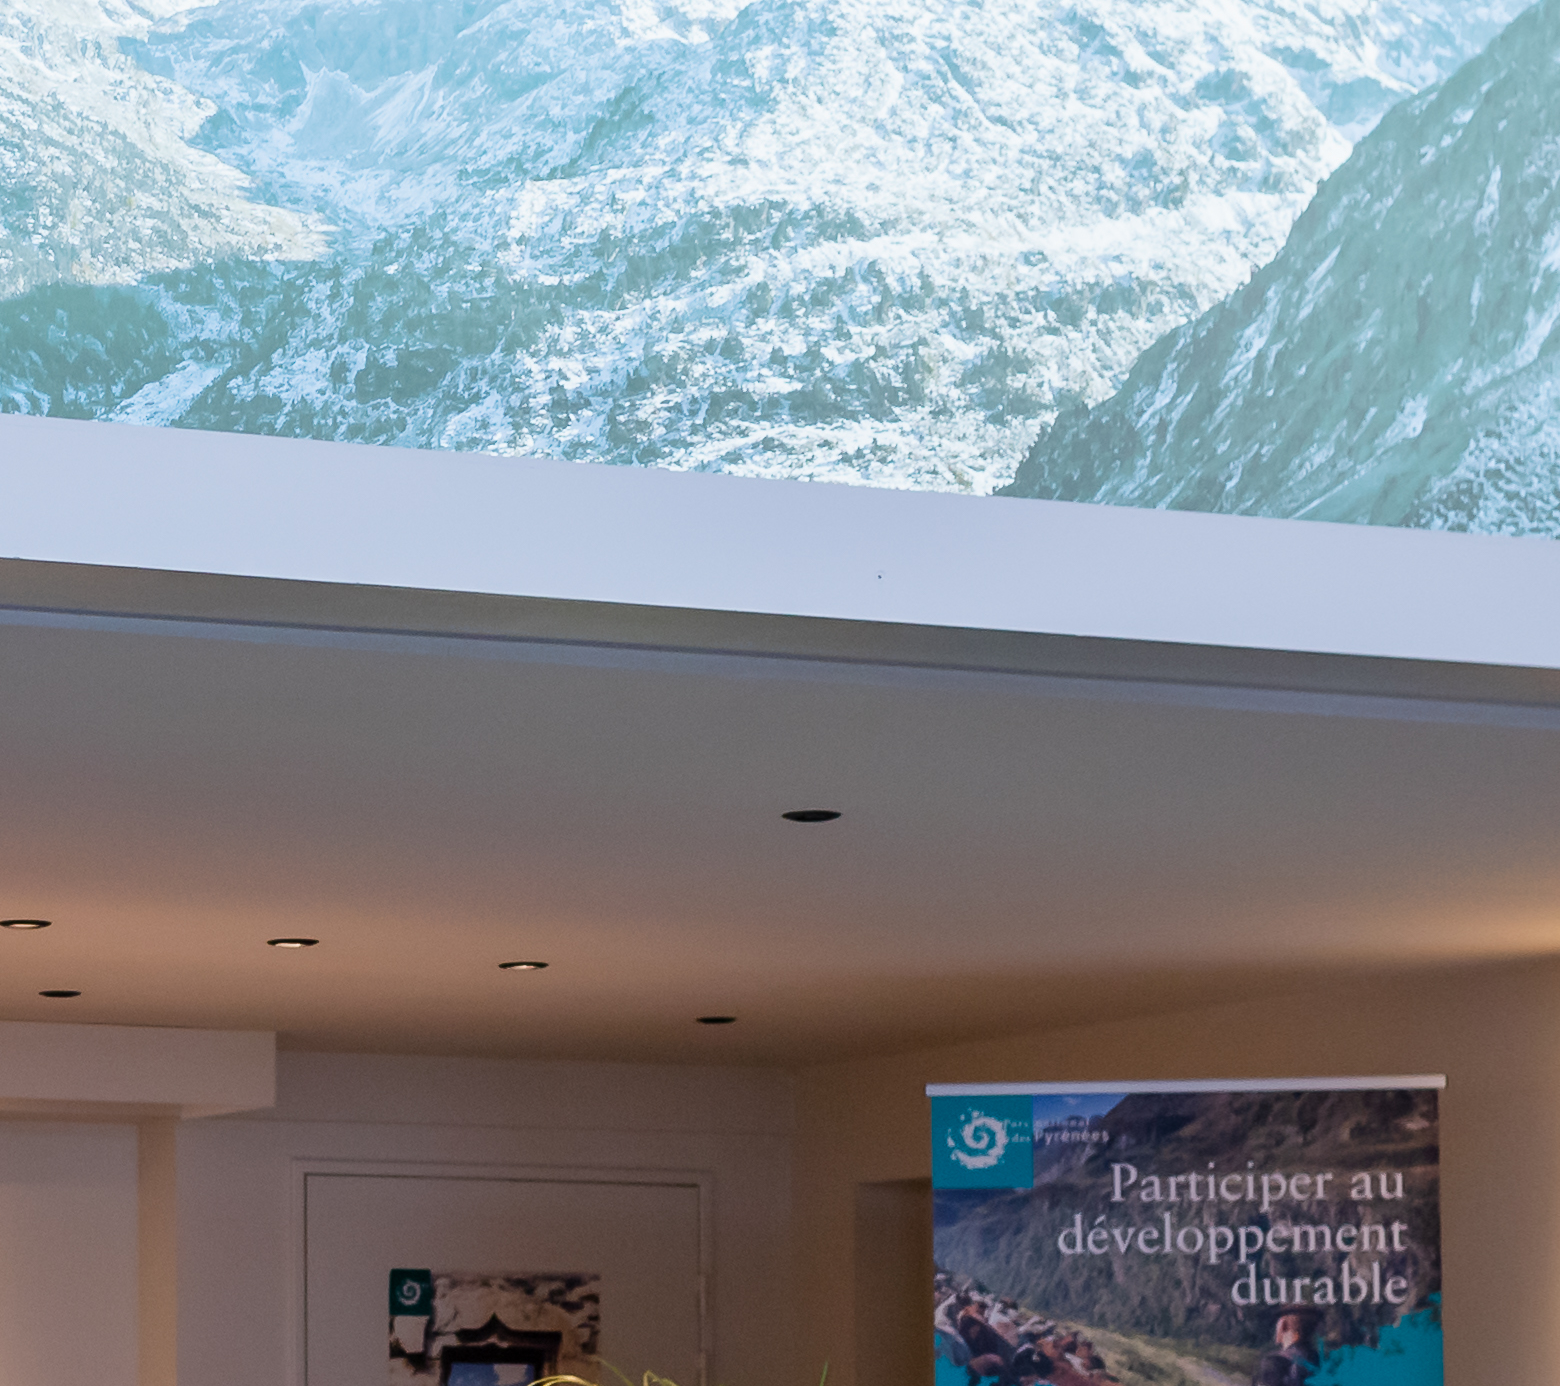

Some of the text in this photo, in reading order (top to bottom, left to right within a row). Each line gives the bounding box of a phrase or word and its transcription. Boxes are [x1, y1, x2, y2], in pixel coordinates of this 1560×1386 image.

[1111, 1161, 1405, 1211] Participer au
[1058, 1213, 1409, 1265] développement
[1231, 1260, 1409, 1307] durable
